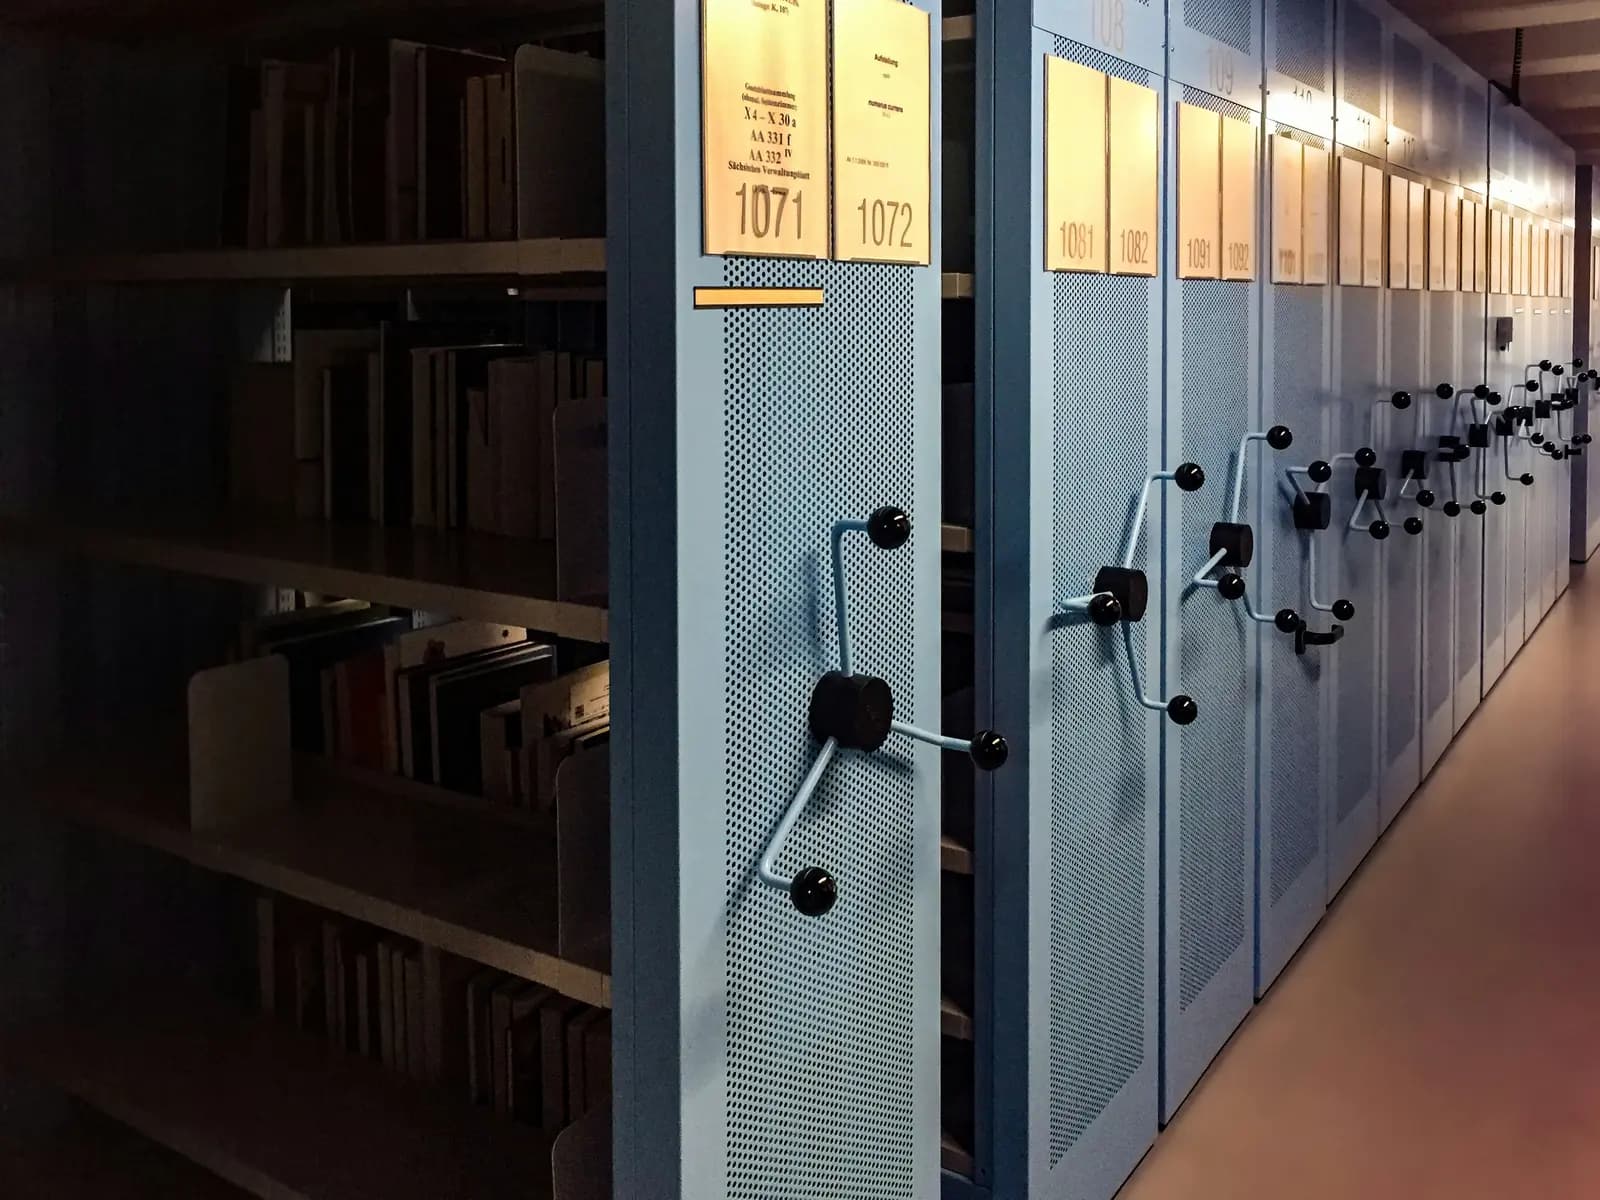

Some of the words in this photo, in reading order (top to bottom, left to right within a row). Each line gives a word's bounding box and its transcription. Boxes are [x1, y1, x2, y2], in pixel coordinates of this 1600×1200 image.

[779, 113, 790, 127] 30
[751, 129, 765, 143] AA
[767, 131, 783, 146] 331
[749, 148, 763, 162] AA
[765, 150, 782, 164] 332
[735, 182, 802, 239] 1071
[857, 198, 912, 247] 1072
[1060, 221, 1093, 259] 1081
[1120, 228, 1148, 264] 1082
[1187, 238, 1210, 269] 1091
[1229, 242, 1249, 271] 1092
